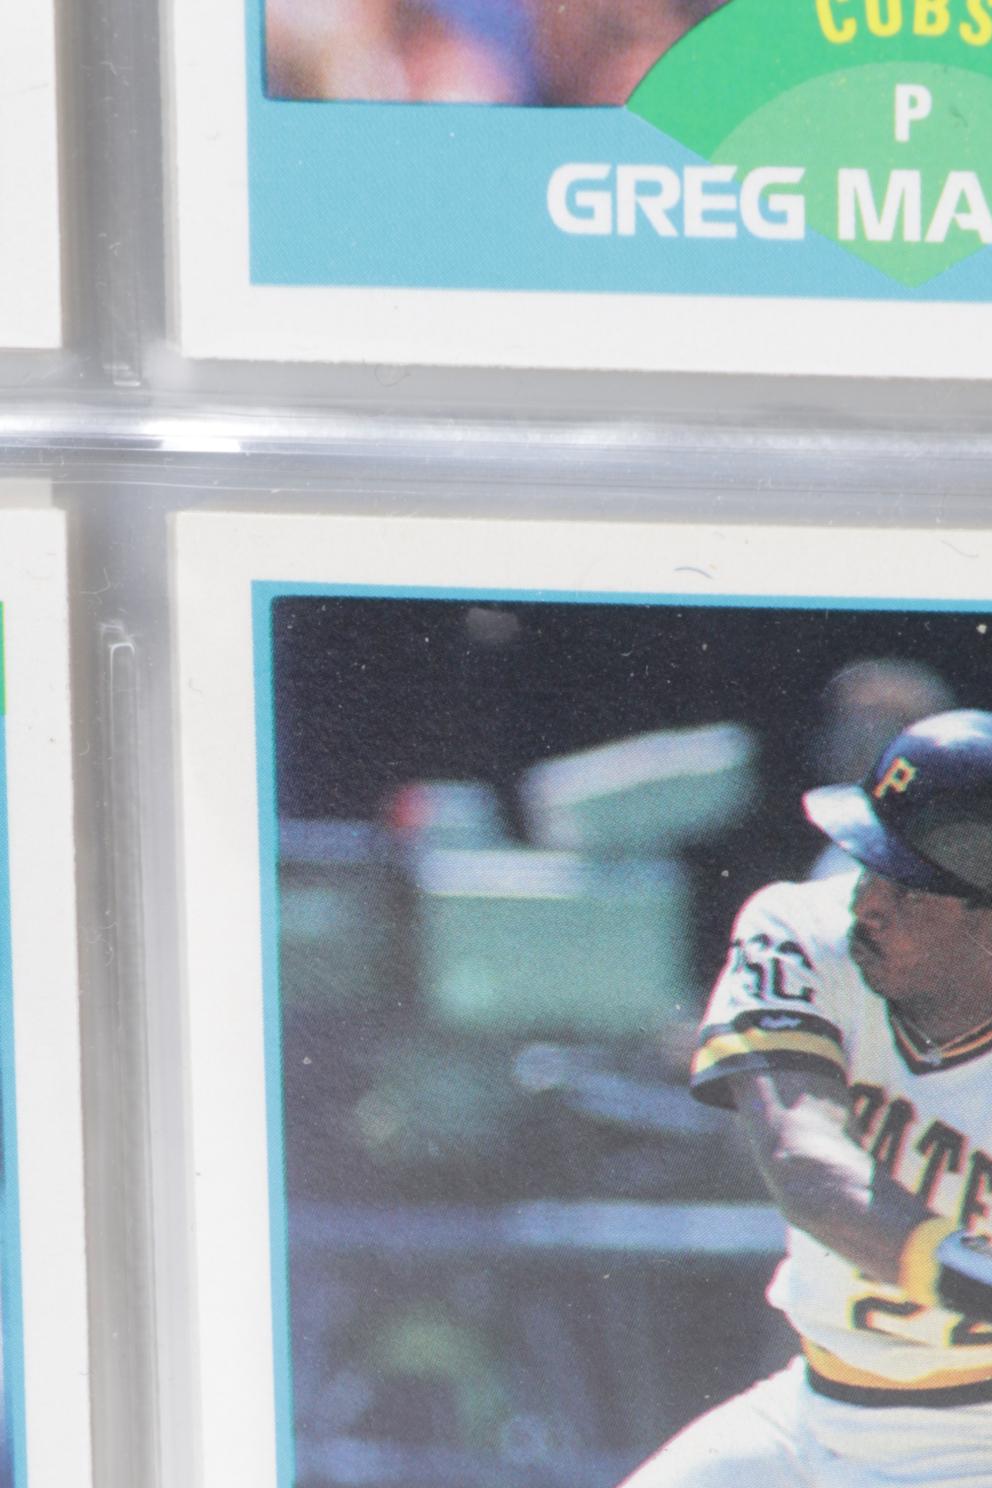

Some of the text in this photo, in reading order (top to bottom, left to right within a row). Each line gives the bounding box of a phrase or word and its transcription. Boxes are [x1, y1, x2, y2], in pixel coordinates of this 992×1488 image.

[893, 83, 933, 143] P
[546, 162, 807, 240] GREG
[872, 756, 917, 799] P
